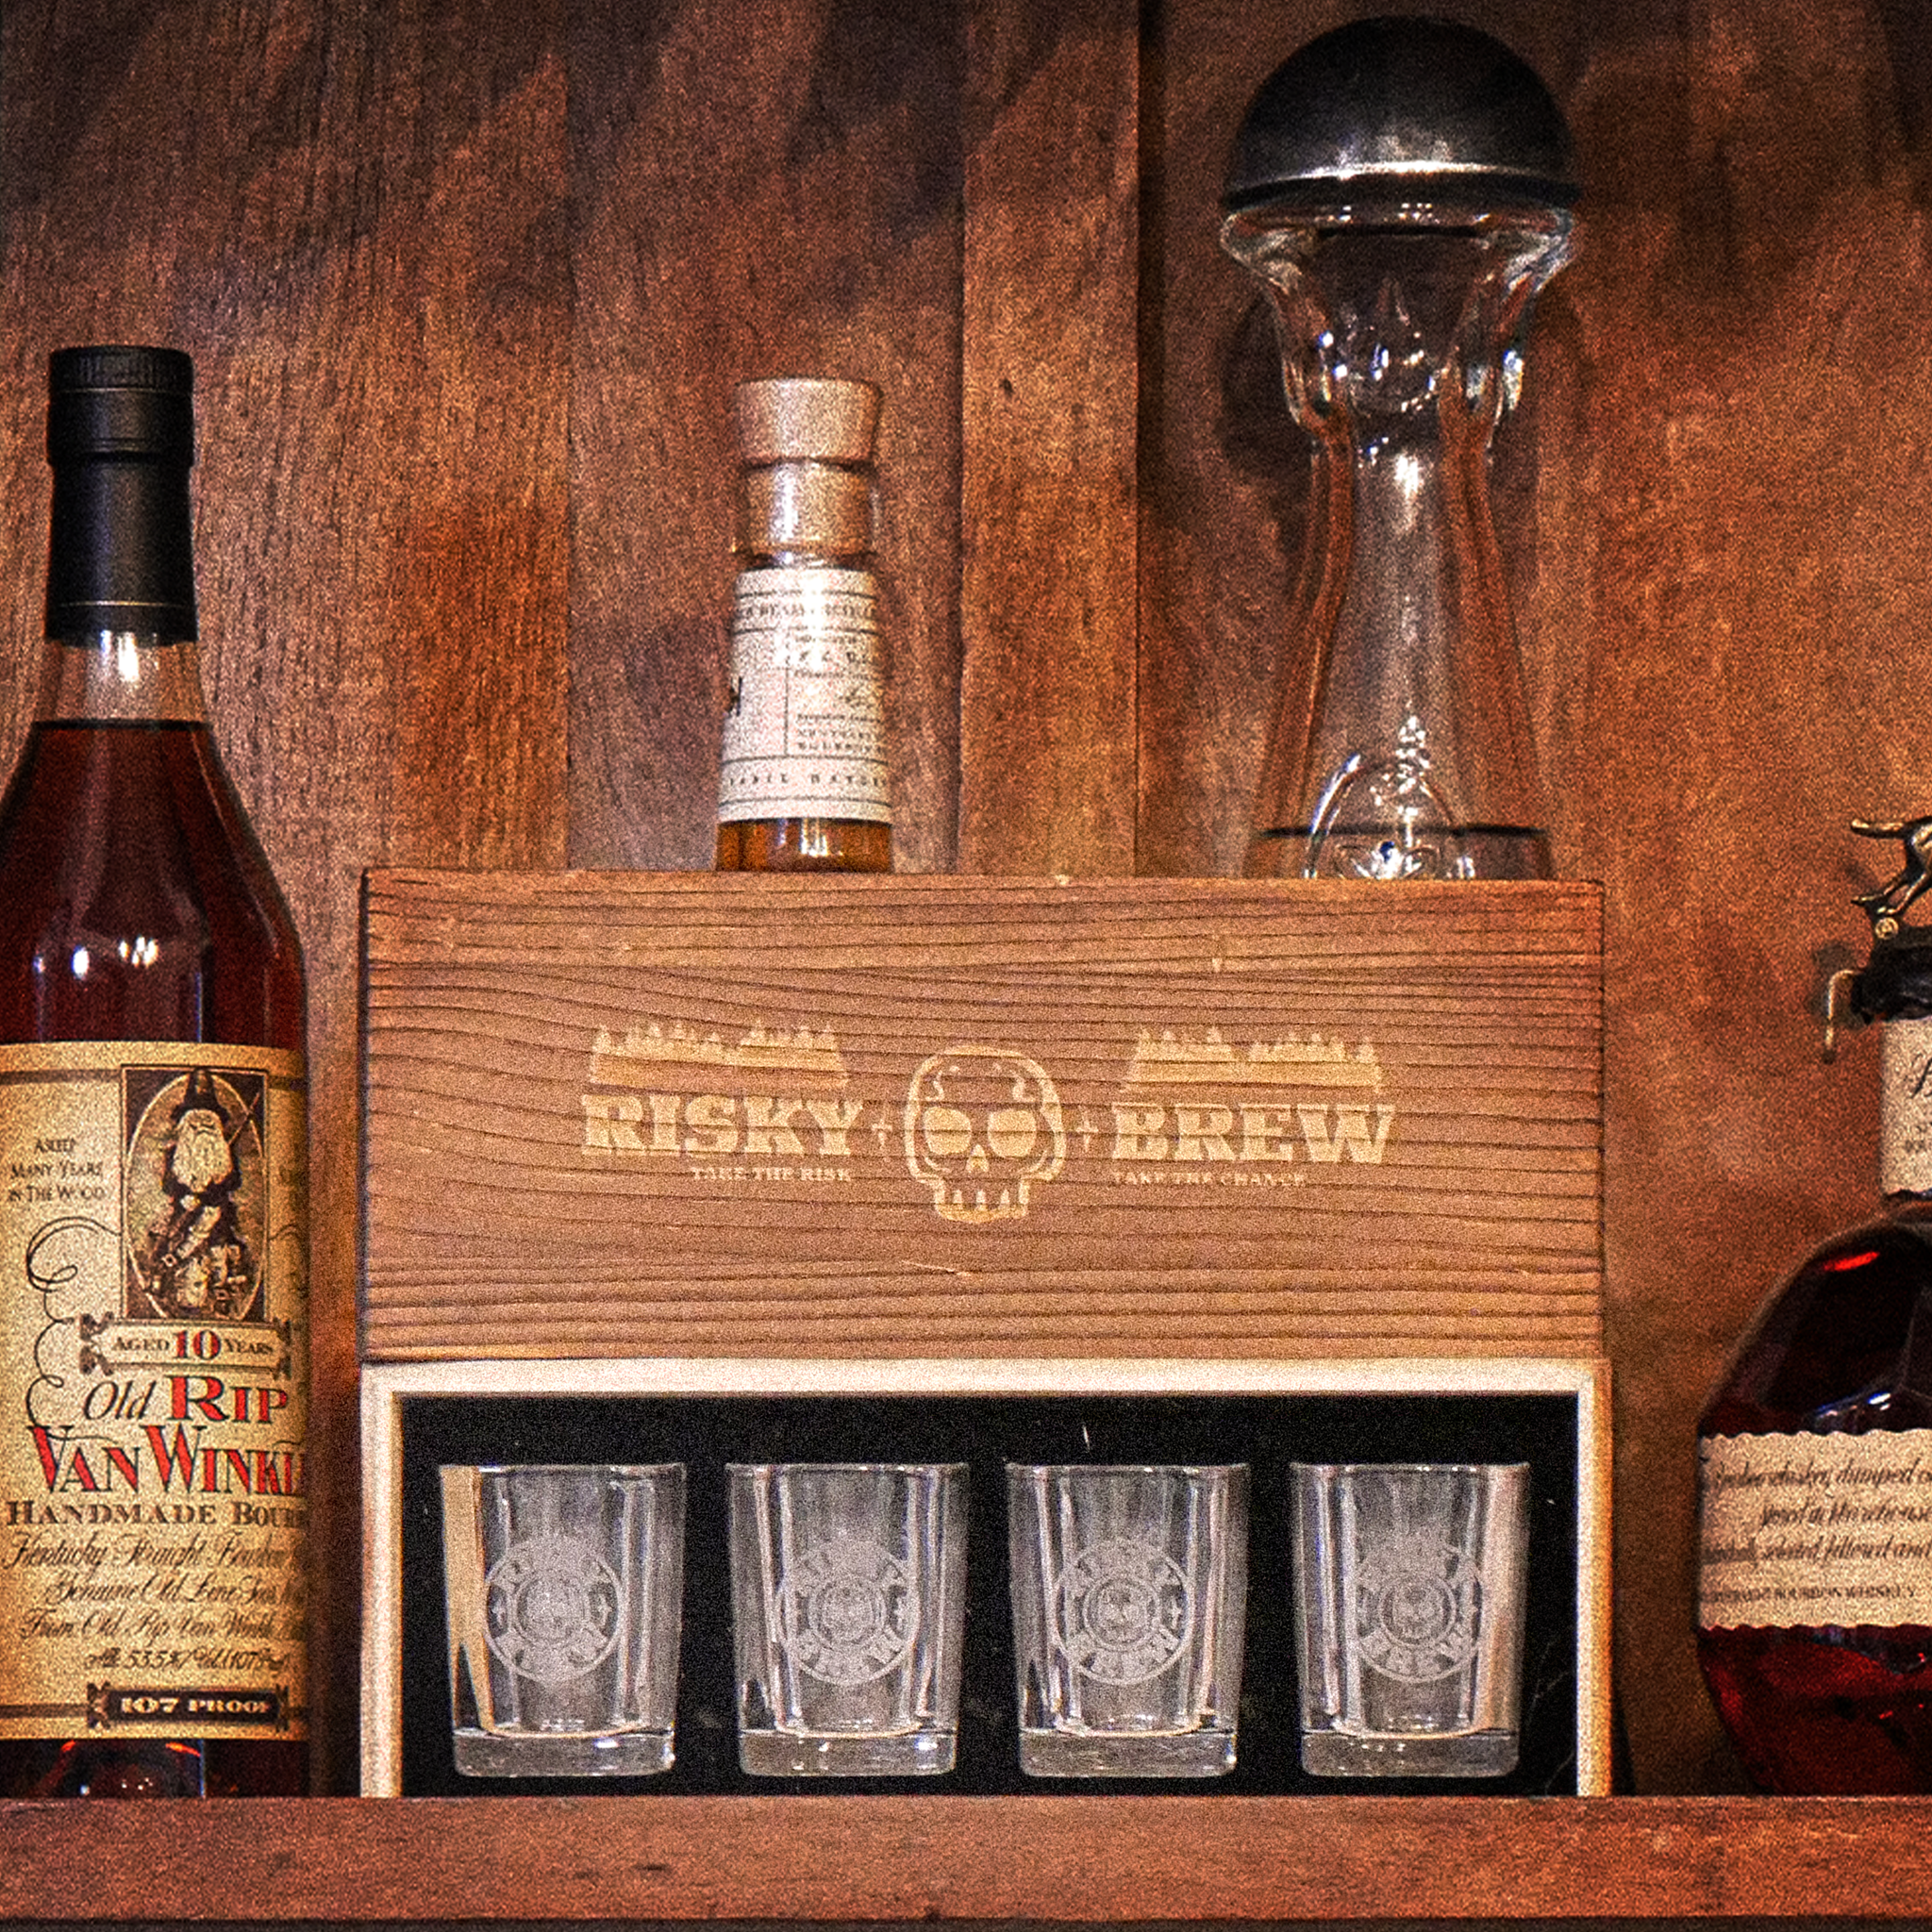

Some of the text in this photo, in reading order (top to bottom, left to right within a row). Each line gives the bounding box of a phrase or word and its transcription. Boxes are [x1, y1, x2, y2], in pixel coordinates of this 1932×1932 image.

[581, 1094, 1395, 1164] RISKY BREW
[689, 1166, 852, 1182] TAKE THE RISK
[1111, 1172, 1307, 1187] TAKE THE CHANCE
[112, 1330, 274, 1360] AGED 10 YEARS
[83, 1374, 290, 1424] Old RIP
[26, 1424, 142, 1493] VAN
[6, 1500, 216, 1526] HANDMADE
[120, 1696, 269, 1715] 107 PROOF
